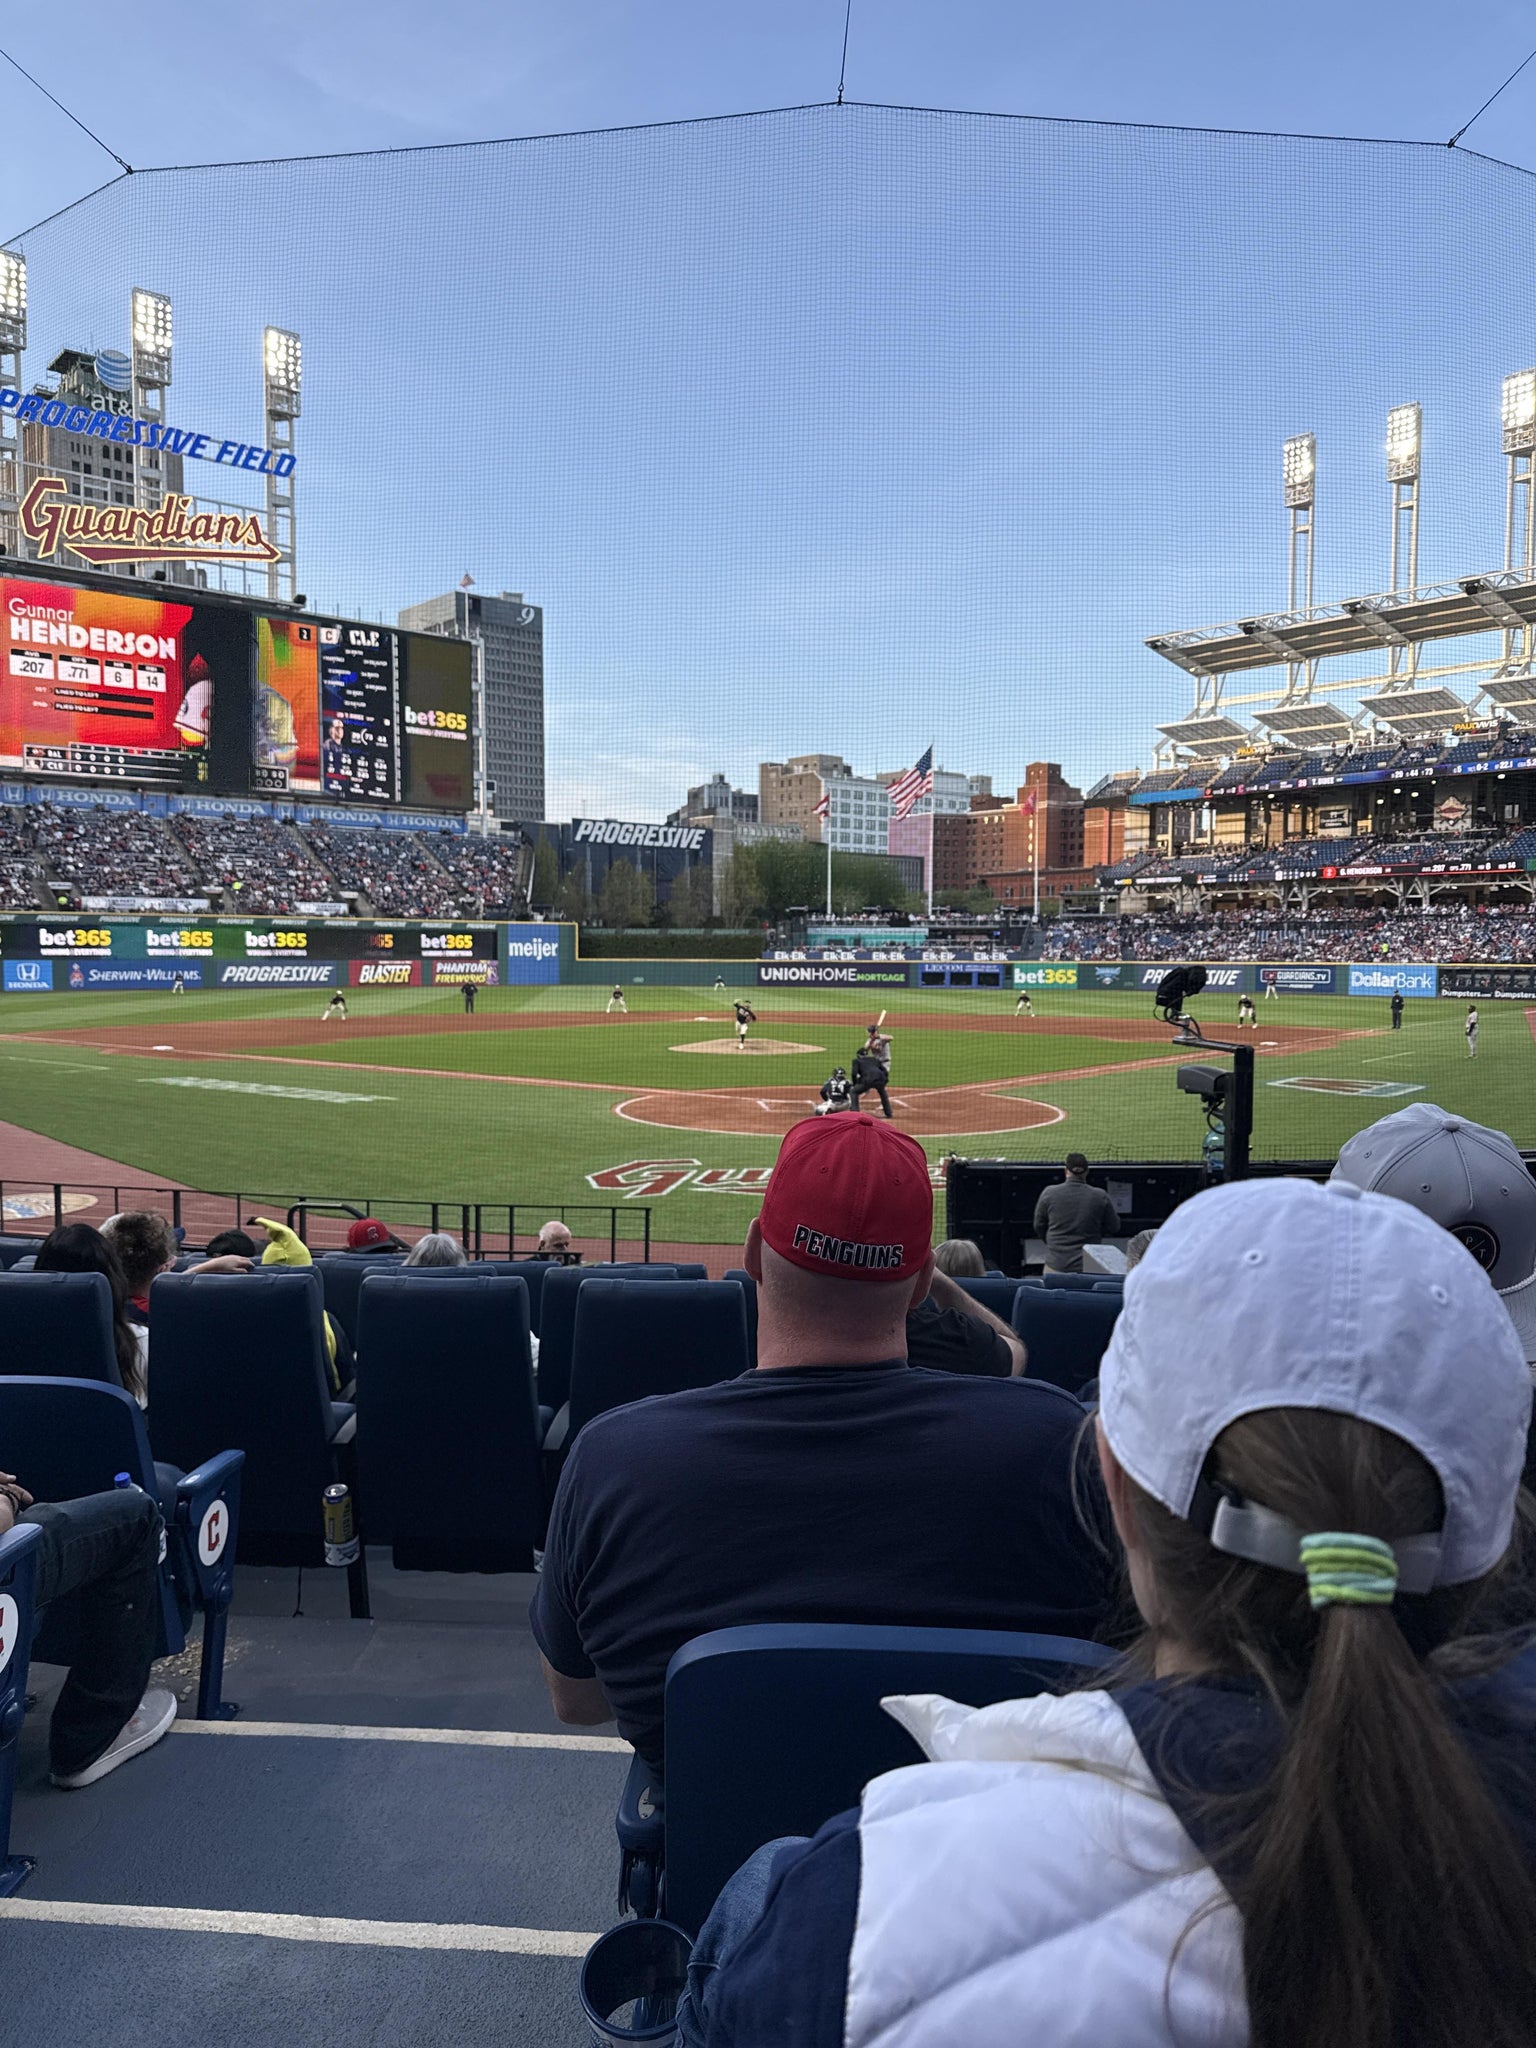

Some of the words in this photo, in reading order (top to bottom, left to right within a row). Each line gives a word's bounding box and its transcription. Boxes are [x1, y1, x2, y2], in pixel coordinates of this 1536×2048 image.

[91, 392, 133, 416] at&
[0, 388, 210, 458] PROGRESSIVE
[216, 440, 297, 478] FIELD
[19, 477, 281, 564] Guardians
[9, 598, 74, 622] Gunnar
[10, 617, 176, 661] HENDERSON
[19, 661, 44, 674] .207
[68, 667, 89, 679] .771
[114, 671, 122, 683] 6
[147, 676, 159, 687] 14
[405, 705, 467, 730] bet365
[56, 791, 135, 805] HONDA
[196, 801, 267, 814] HONDA
[319, 811, 382, 824] HONDA
[402, 817, 460, 829] HONDA
[574, 820, 705, 849] PROGRESSIVE
[39, 928, 112, 946] bet365
[147, 929, 213, 947] bet365
[245, 930, 307, 948] bet365
[420, 933, 473, 949] bet365
[509, 938, 558, 960] meijer
[221, 966, 334, 982] PROGRESSIVE
[359, 964, 412, 984] BLASTER
[436, 962, 487, 973] PHANTOM
[1014, 968, 1077, 984] bet365
[435, 974, 486, 983] FIREWORKS
[857, 973, 905, 982] MORTGAGE
[792, 1224, 905, 1269] PENGUINS
[207, 1510, 221, 1551] C
